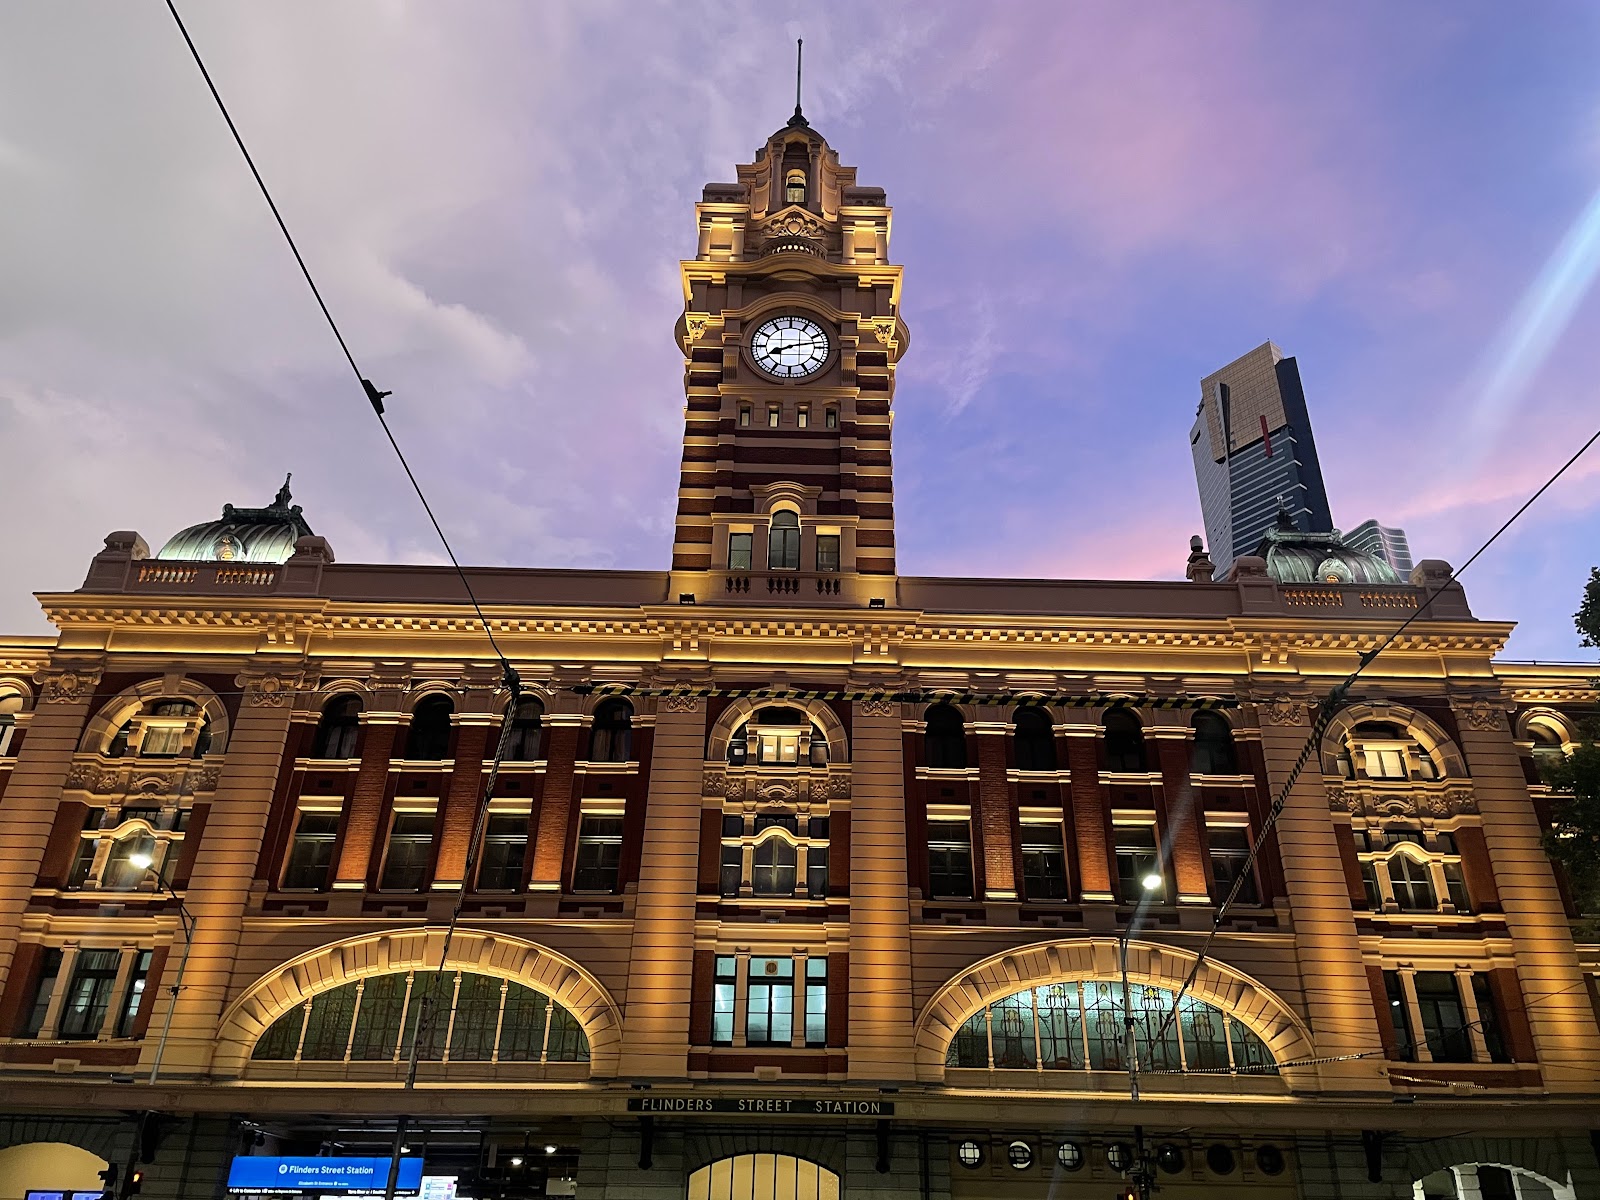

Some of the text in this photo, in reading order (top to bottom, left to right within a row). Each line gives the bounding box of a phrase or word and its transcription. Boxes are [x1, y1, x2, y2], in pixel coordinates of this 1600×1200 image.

[641, 1098, 880, 1114] FLINDERS STREET STATION
[289, 1165, 374, 1175] Flinders Street Station
